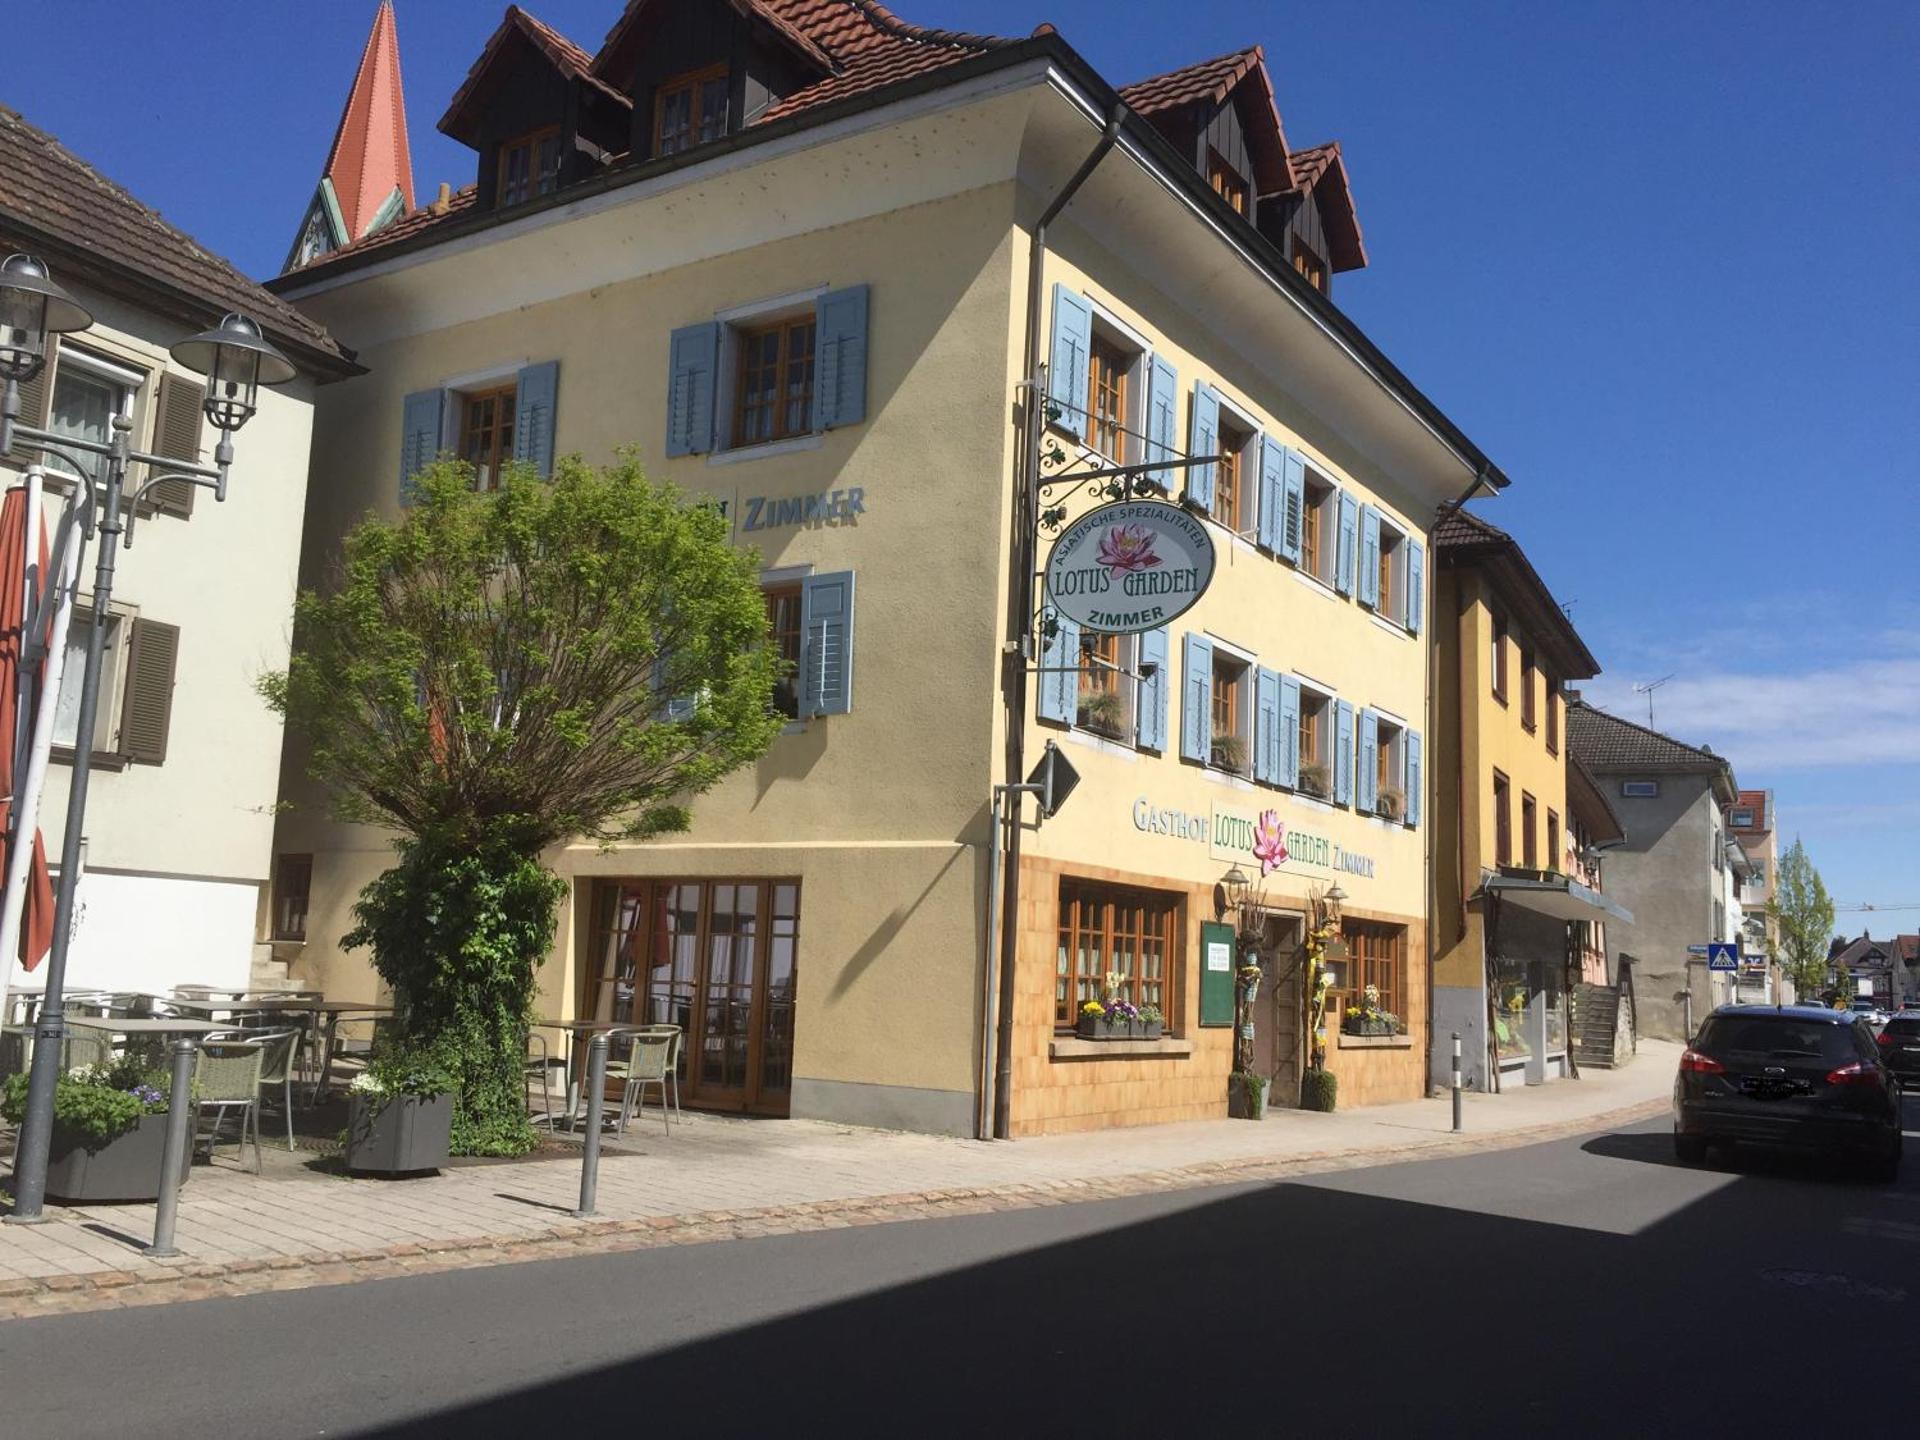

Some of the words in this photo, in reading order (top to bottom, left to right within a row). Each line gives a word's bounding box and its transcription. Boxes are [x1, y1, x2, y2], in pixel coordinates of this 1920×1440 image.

[742, 487, 867, 532] ZIMMER
[1055, 512, 1117, 567] ASIATISCHE
[1055, 567, 1111, 597] LOTUS
[1123, 567, 1199, 597] GARDEN
[1088, 606, 1164, 626] ZIMMER
[1214, 813, 1253, 851] LOTUS
[1287, 831, 1330, 868] GARDEN
